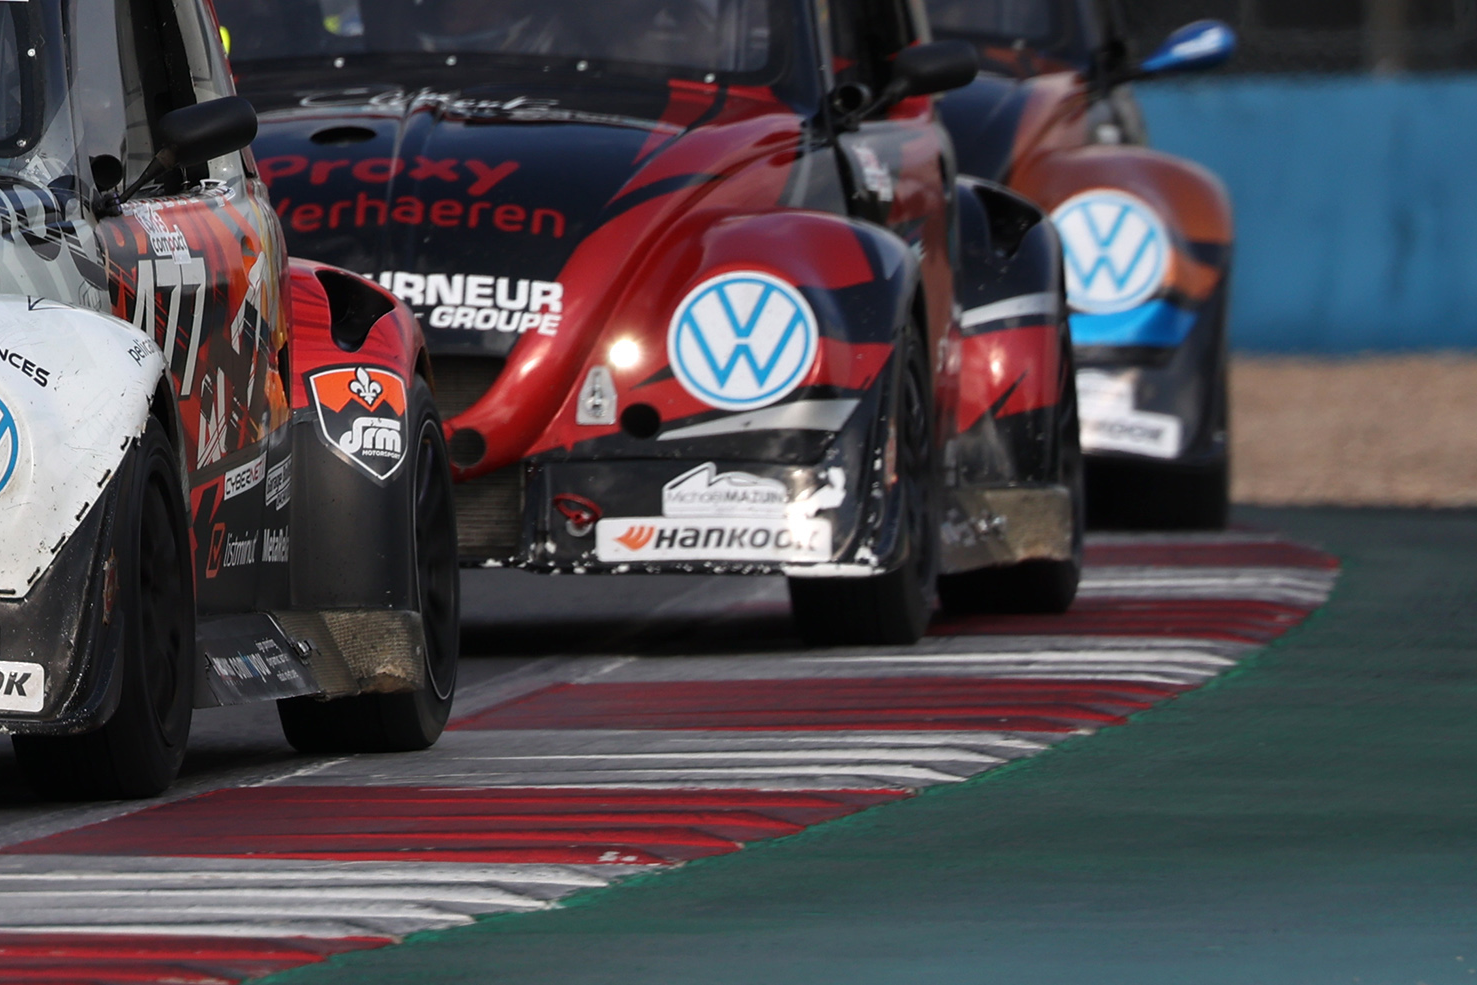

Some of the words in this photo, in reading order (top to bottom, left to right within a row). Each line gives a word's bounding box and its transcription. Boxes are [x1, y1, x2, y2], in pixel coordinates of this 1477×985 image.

[257, 154, 521, 196] Proxy
[428, 305, 563, 337] GROUPE
[361, 449, 402, 460] MOTORSPORT
[654, 526, 822, 552] HANKOO
